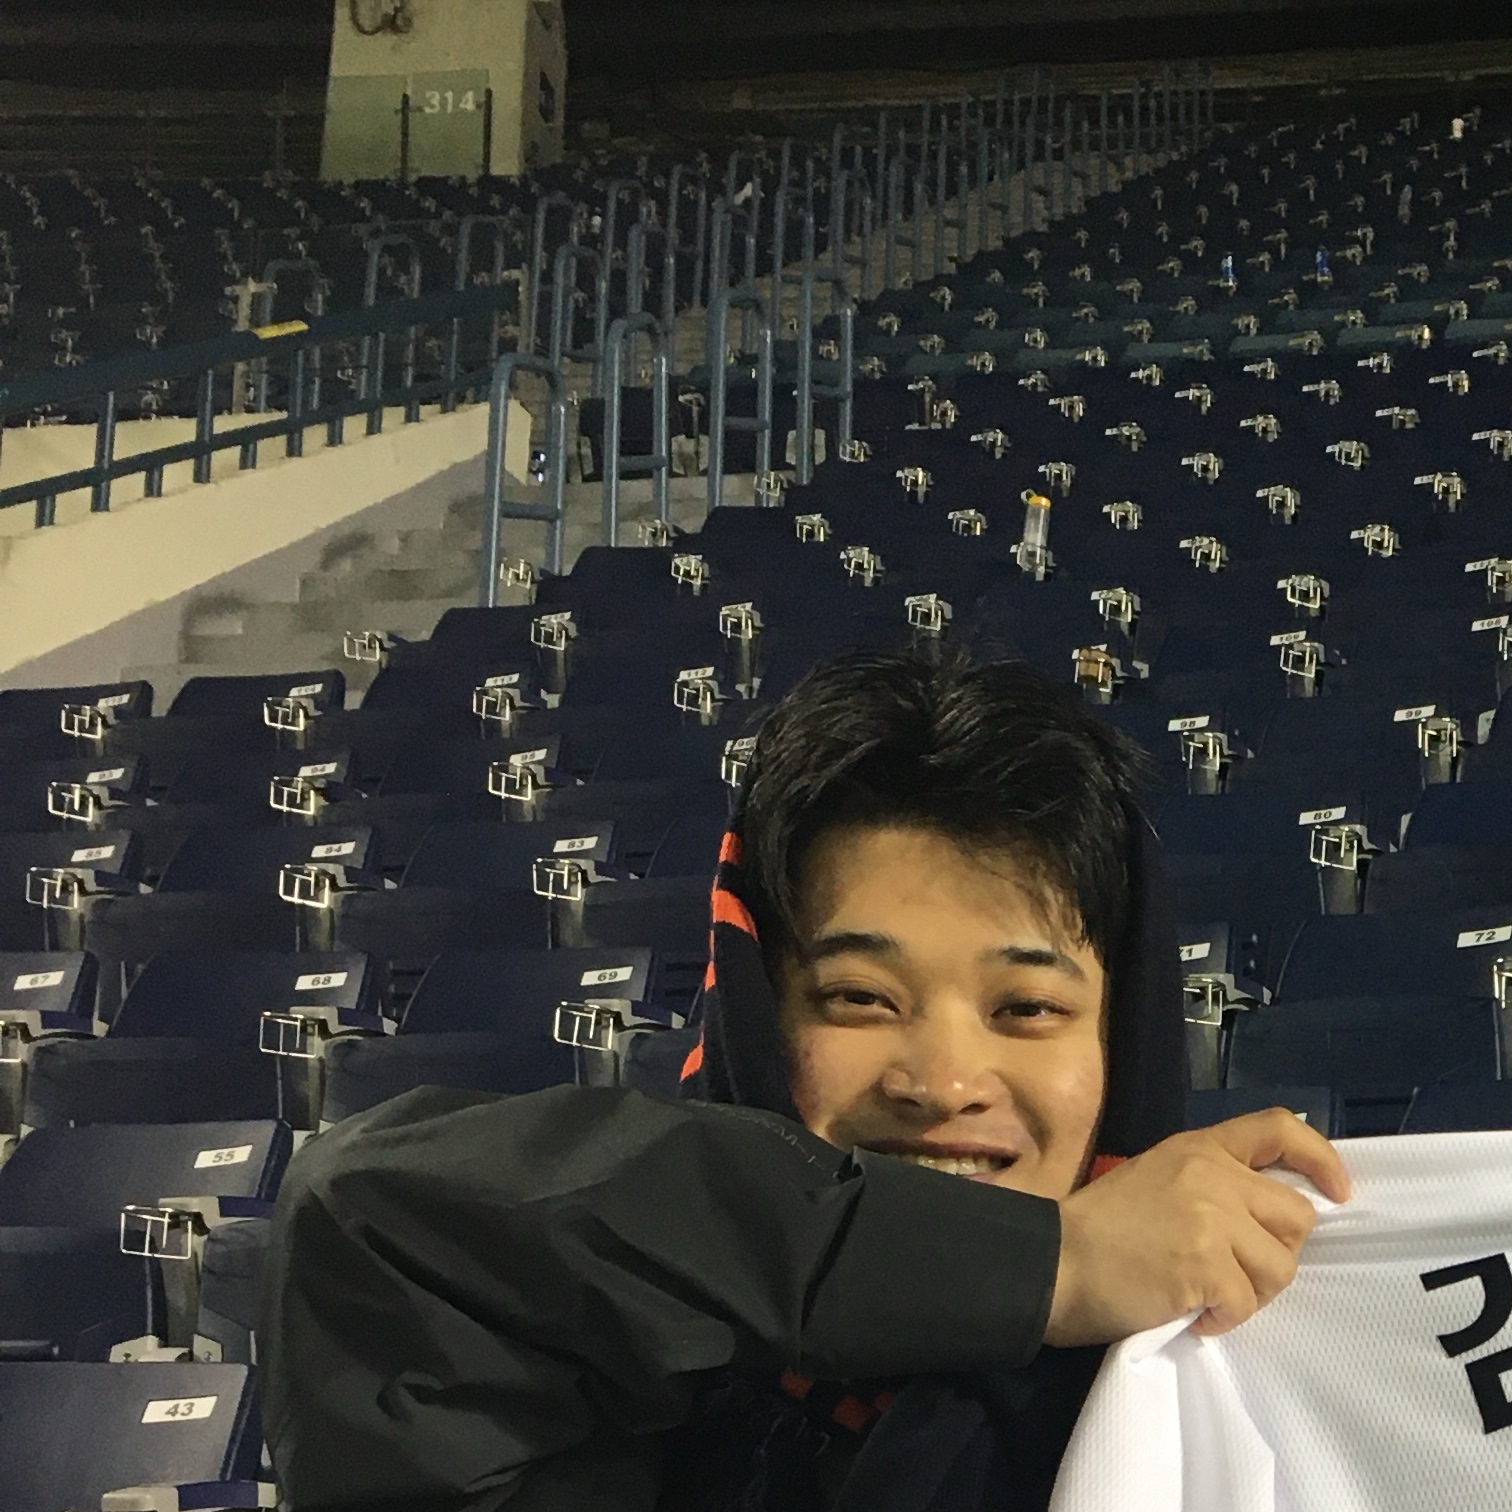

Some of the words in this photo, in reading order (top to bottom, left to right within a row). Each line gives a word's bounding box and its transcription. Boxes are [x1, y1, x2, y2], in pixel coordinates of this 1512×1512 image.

[424, 91, 476, 113] 314
[1405, 708, 1423, 719] 99
[1179, 720, 1197, 729] 98
[1313, 810, 1333, 821] 80
[567, 839, 585, 850] 83
[1475, 930, 1497, 943] 72
[29, 974, 51, 987] 67
[311, 975, 333, 987] 68
[597, 970, 619, 982] 69
[212, 1150, 236, 1163] 55
[165, 1402, 194, 1417] 43
